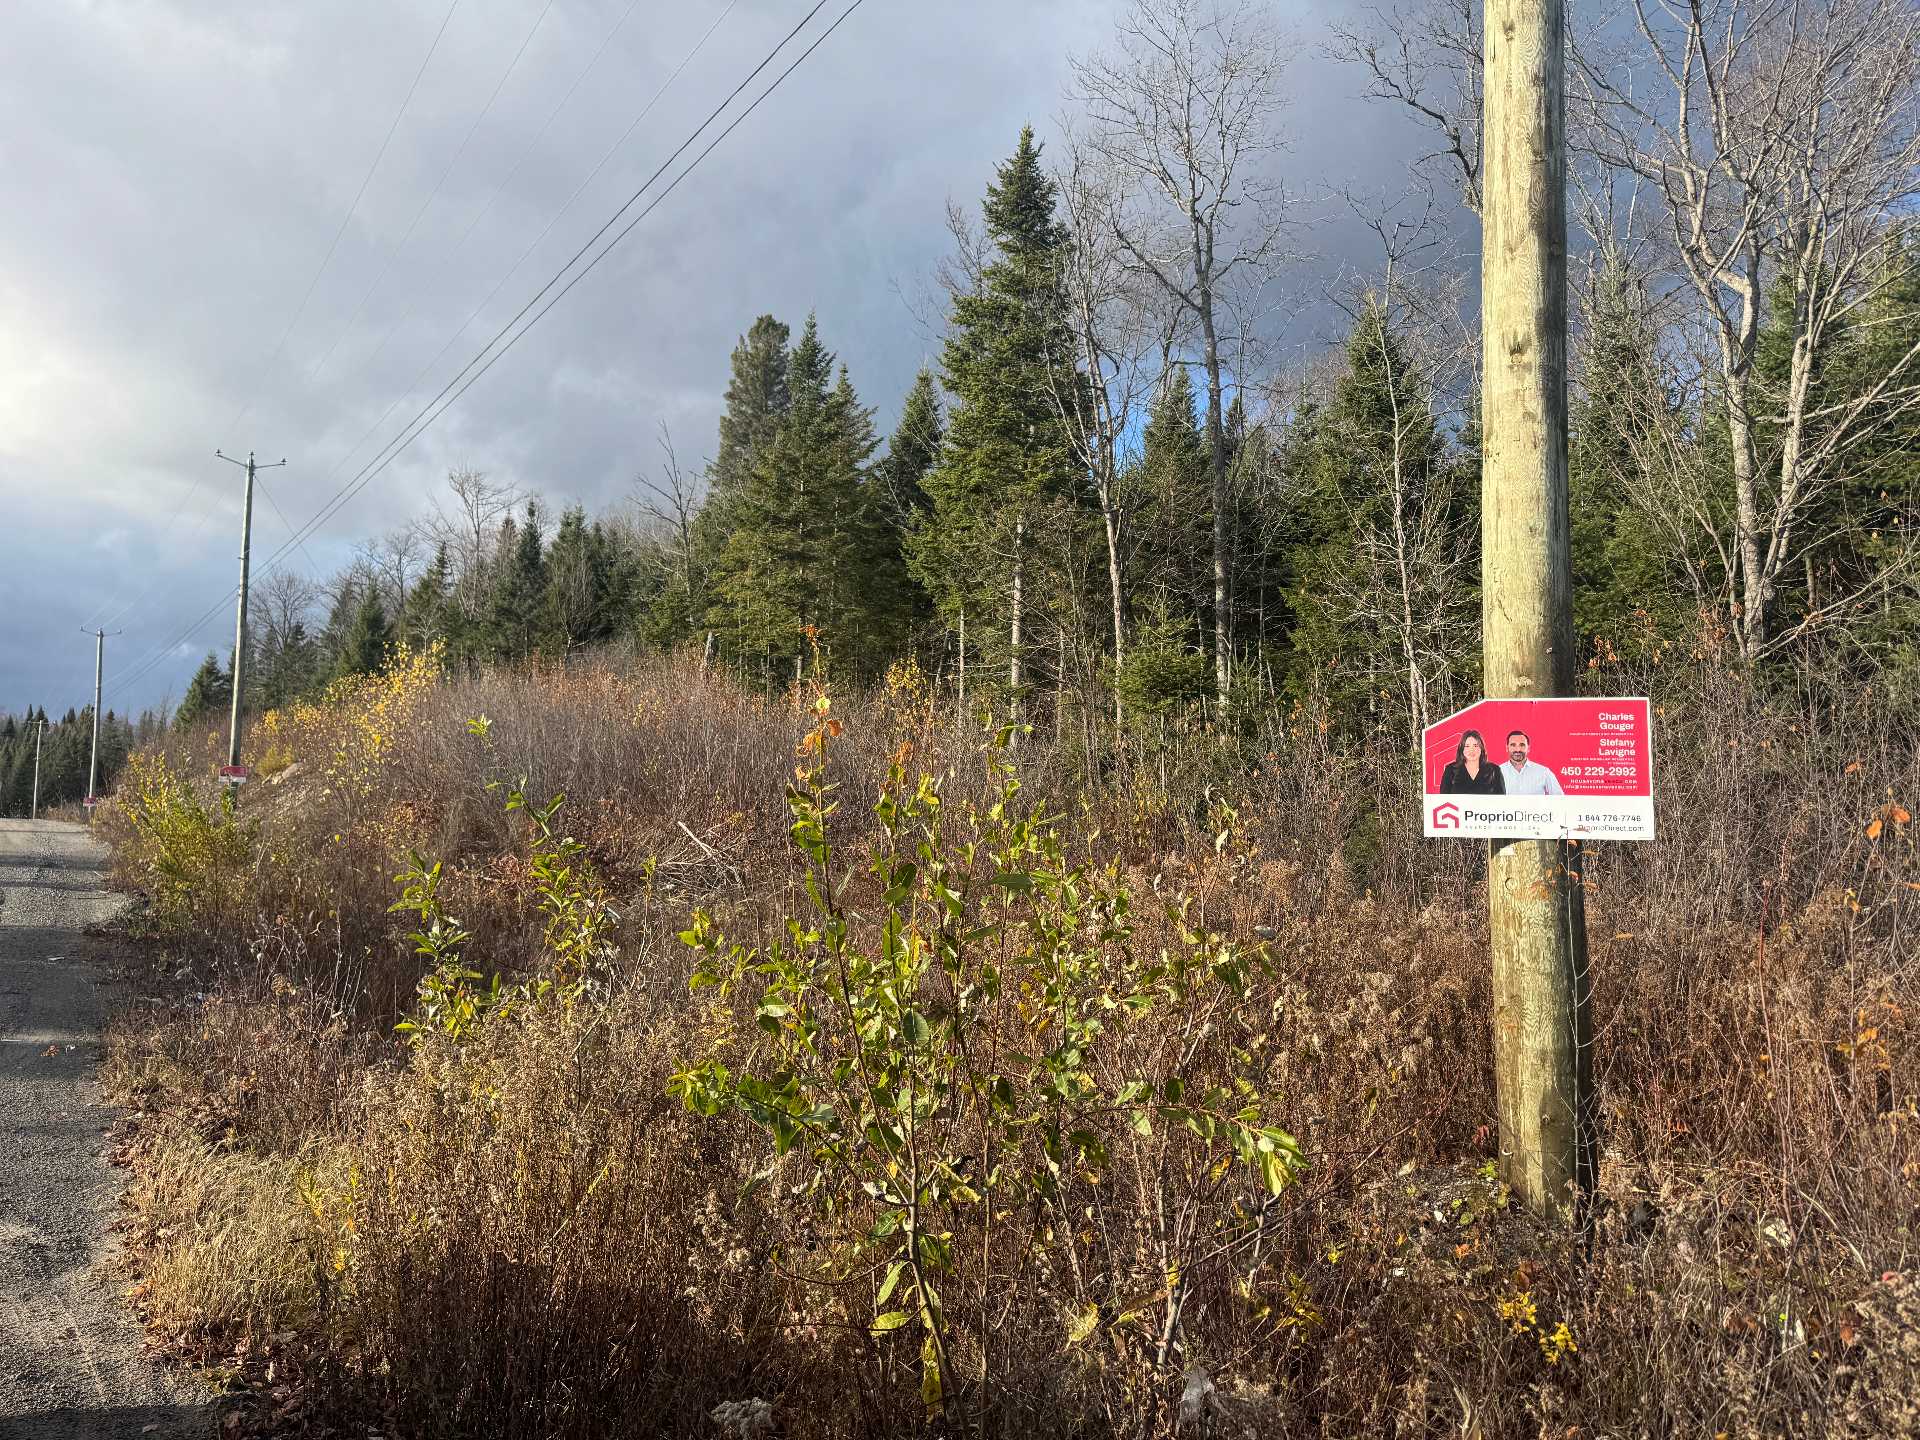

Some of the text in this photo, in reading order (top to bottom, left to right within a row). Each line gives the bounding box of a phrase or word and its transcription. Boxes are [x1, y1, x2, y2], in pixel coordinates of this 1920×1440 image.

[1598, 712, 1635, 721] Charles
[1599, 722, 1635, 731] Gouger
[1599, 738, 1636, 748] Stefany
[1598, 748, 1636, 757] Lavigne
[1560, 766, 1637, 776] 450 229-2992
[1464, 810, 1553, 823] ProprioDirect
